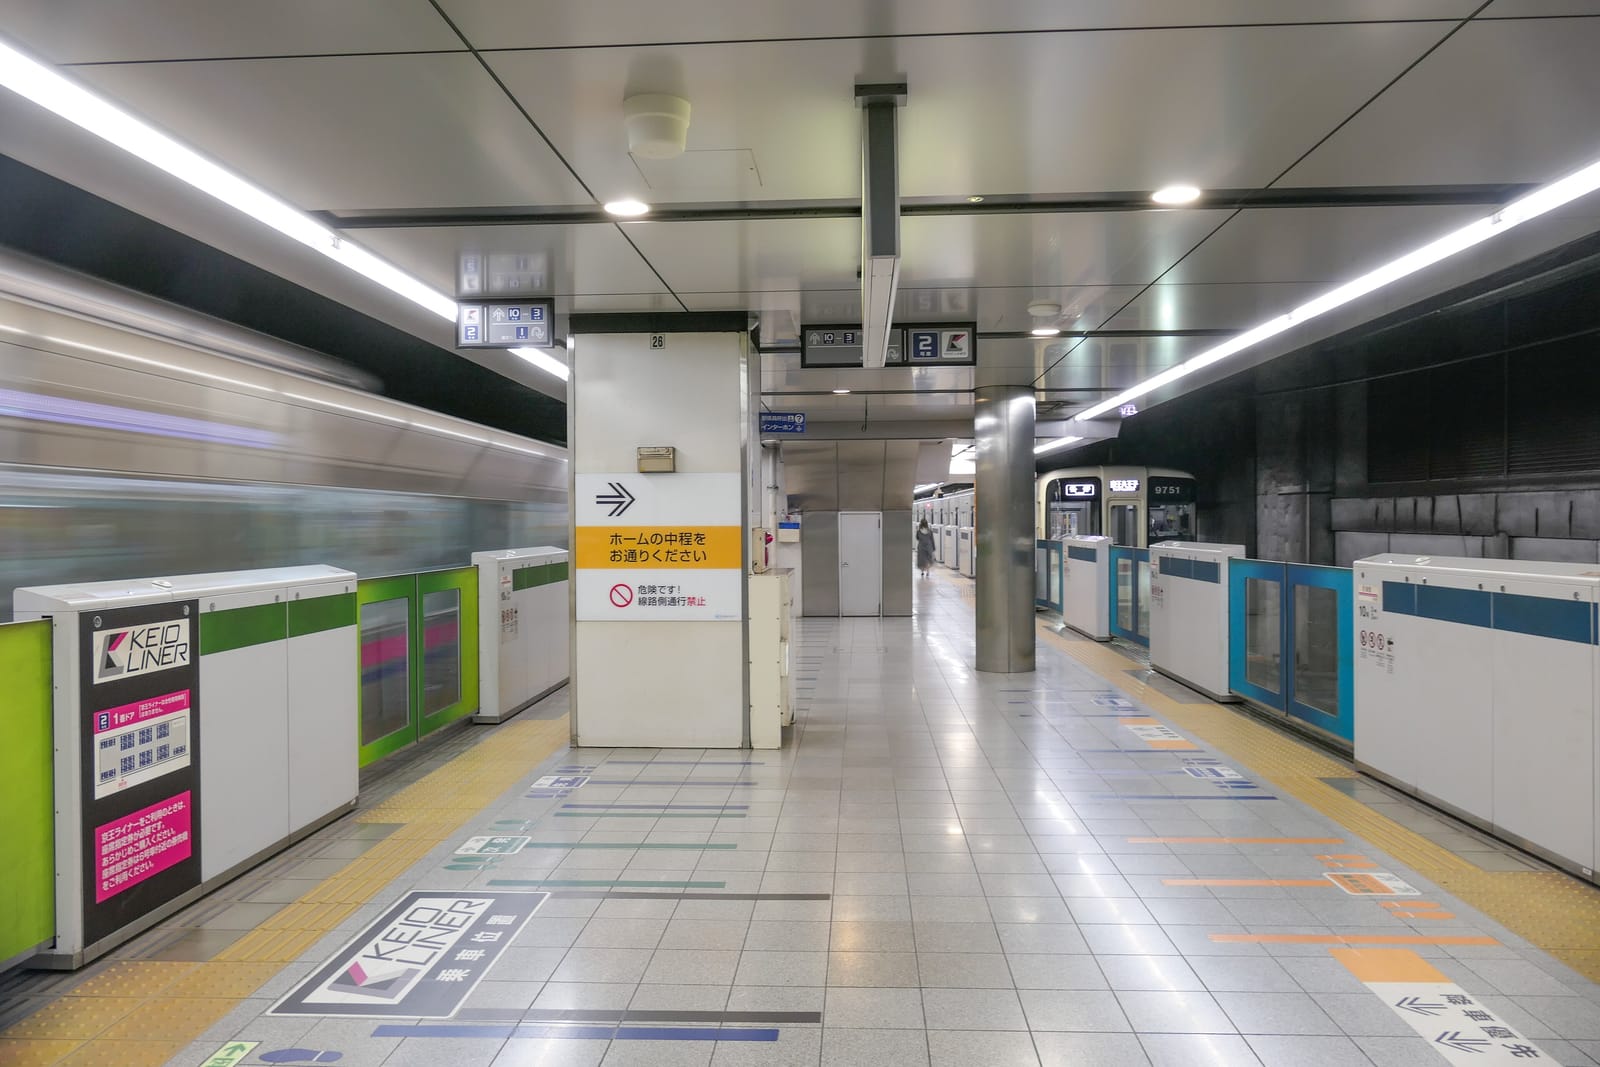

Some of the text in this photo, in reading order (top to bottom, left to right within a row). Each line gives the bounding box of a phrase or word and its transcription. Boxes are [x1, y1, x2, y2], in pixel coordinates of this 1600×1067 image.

[509, 308, 541, 317] 10 3
[467, 327, 476, 336] 2
[824, 333, 834, 341] 10
[918, 335, 932, 350] 2
[1155, 486, 1180, 494] 9751
[609, 532, 707, 546] ホームの中程を
[609, 549, 707, 563] お通りください
[637, 585, 681, 595] 危険です!
[637, 596, 706, 606] 線路側通行禁止
[130, 624, 180, 651] KEIO
[126, 643, 188, 673] LINER
[100, 713, 108, 726] 2
[362, 906, 442, 961] KEIO
[396, 900, 486, 965] LINER
[435, 914, 518, 982] 乗車位置
[1439, 993, 1541, 1059] 降車優先
